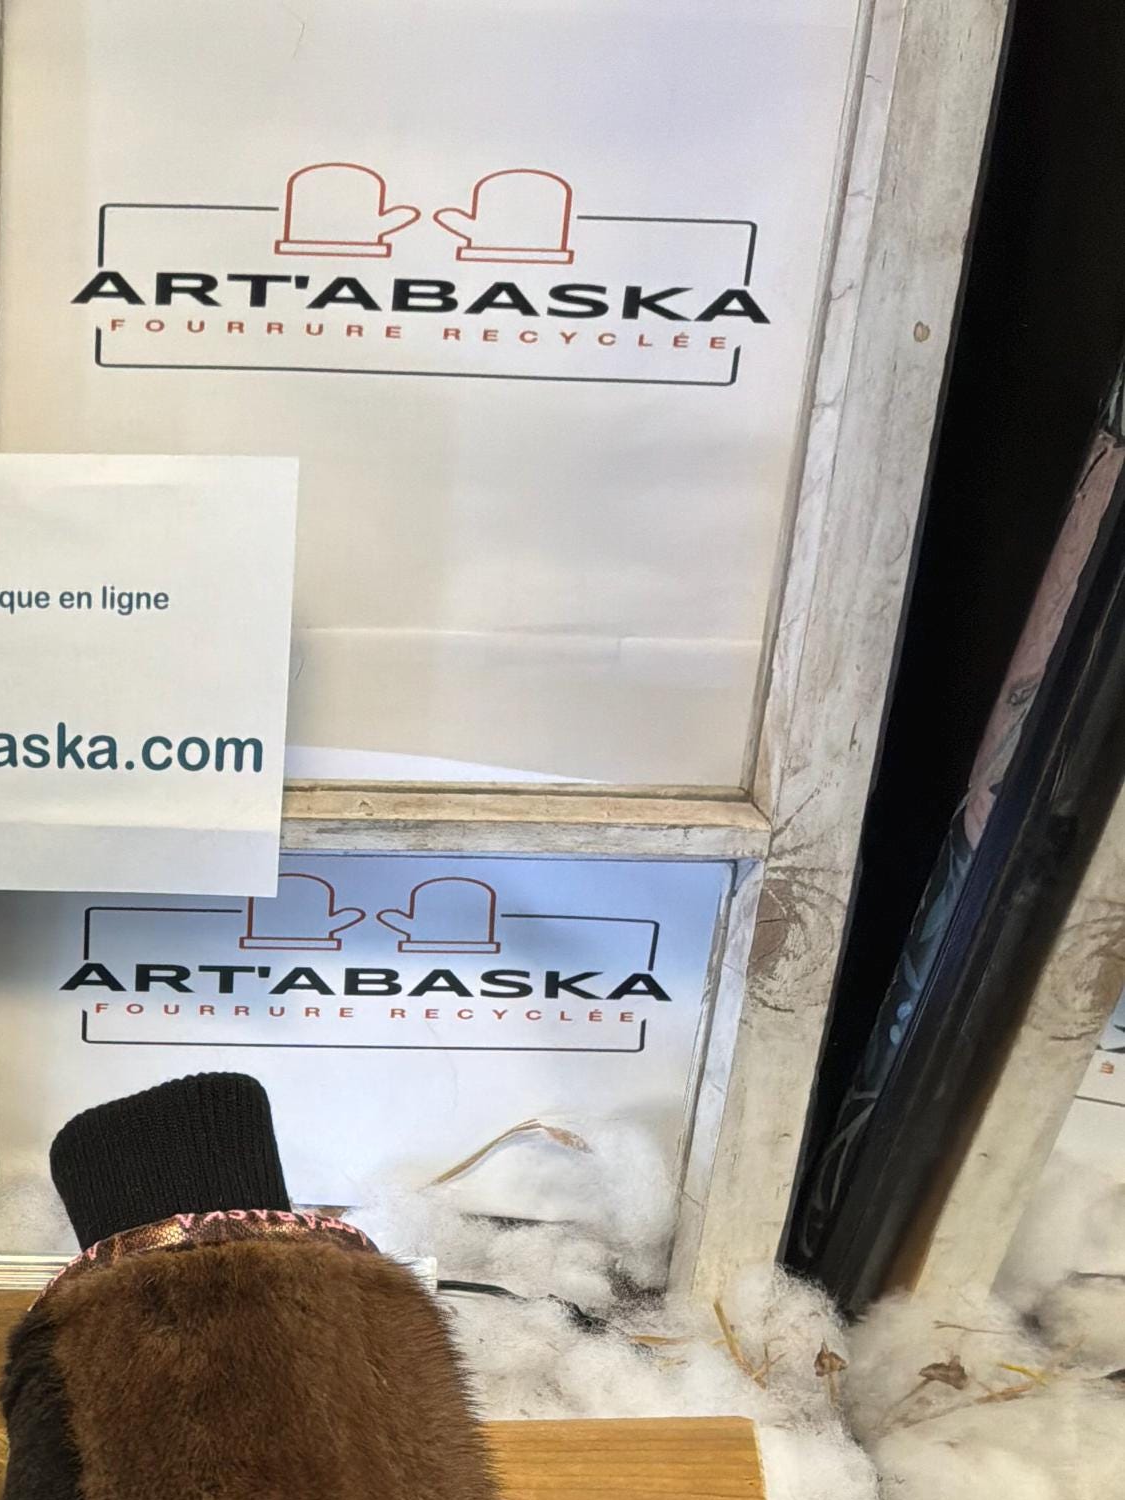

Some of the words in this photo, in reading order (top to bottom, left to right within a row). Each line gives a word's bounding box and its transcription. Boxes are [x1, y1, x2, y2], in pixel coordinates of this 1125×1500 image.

[71, 271, 772, 324] ART'ABASKA
[109, 317, 403, 340] FOURRURE
[442, 327, 728, 351] RECYCLÉE
[59, 591, 92, 609] en
[101, 585, 169, 616] ligne
[59, 962, 672, 1002] ART'ABASKA
[94, 1002, 355, 1018] FOURRURE
[390, 1007, 636, 1023] RECYCLÉE
